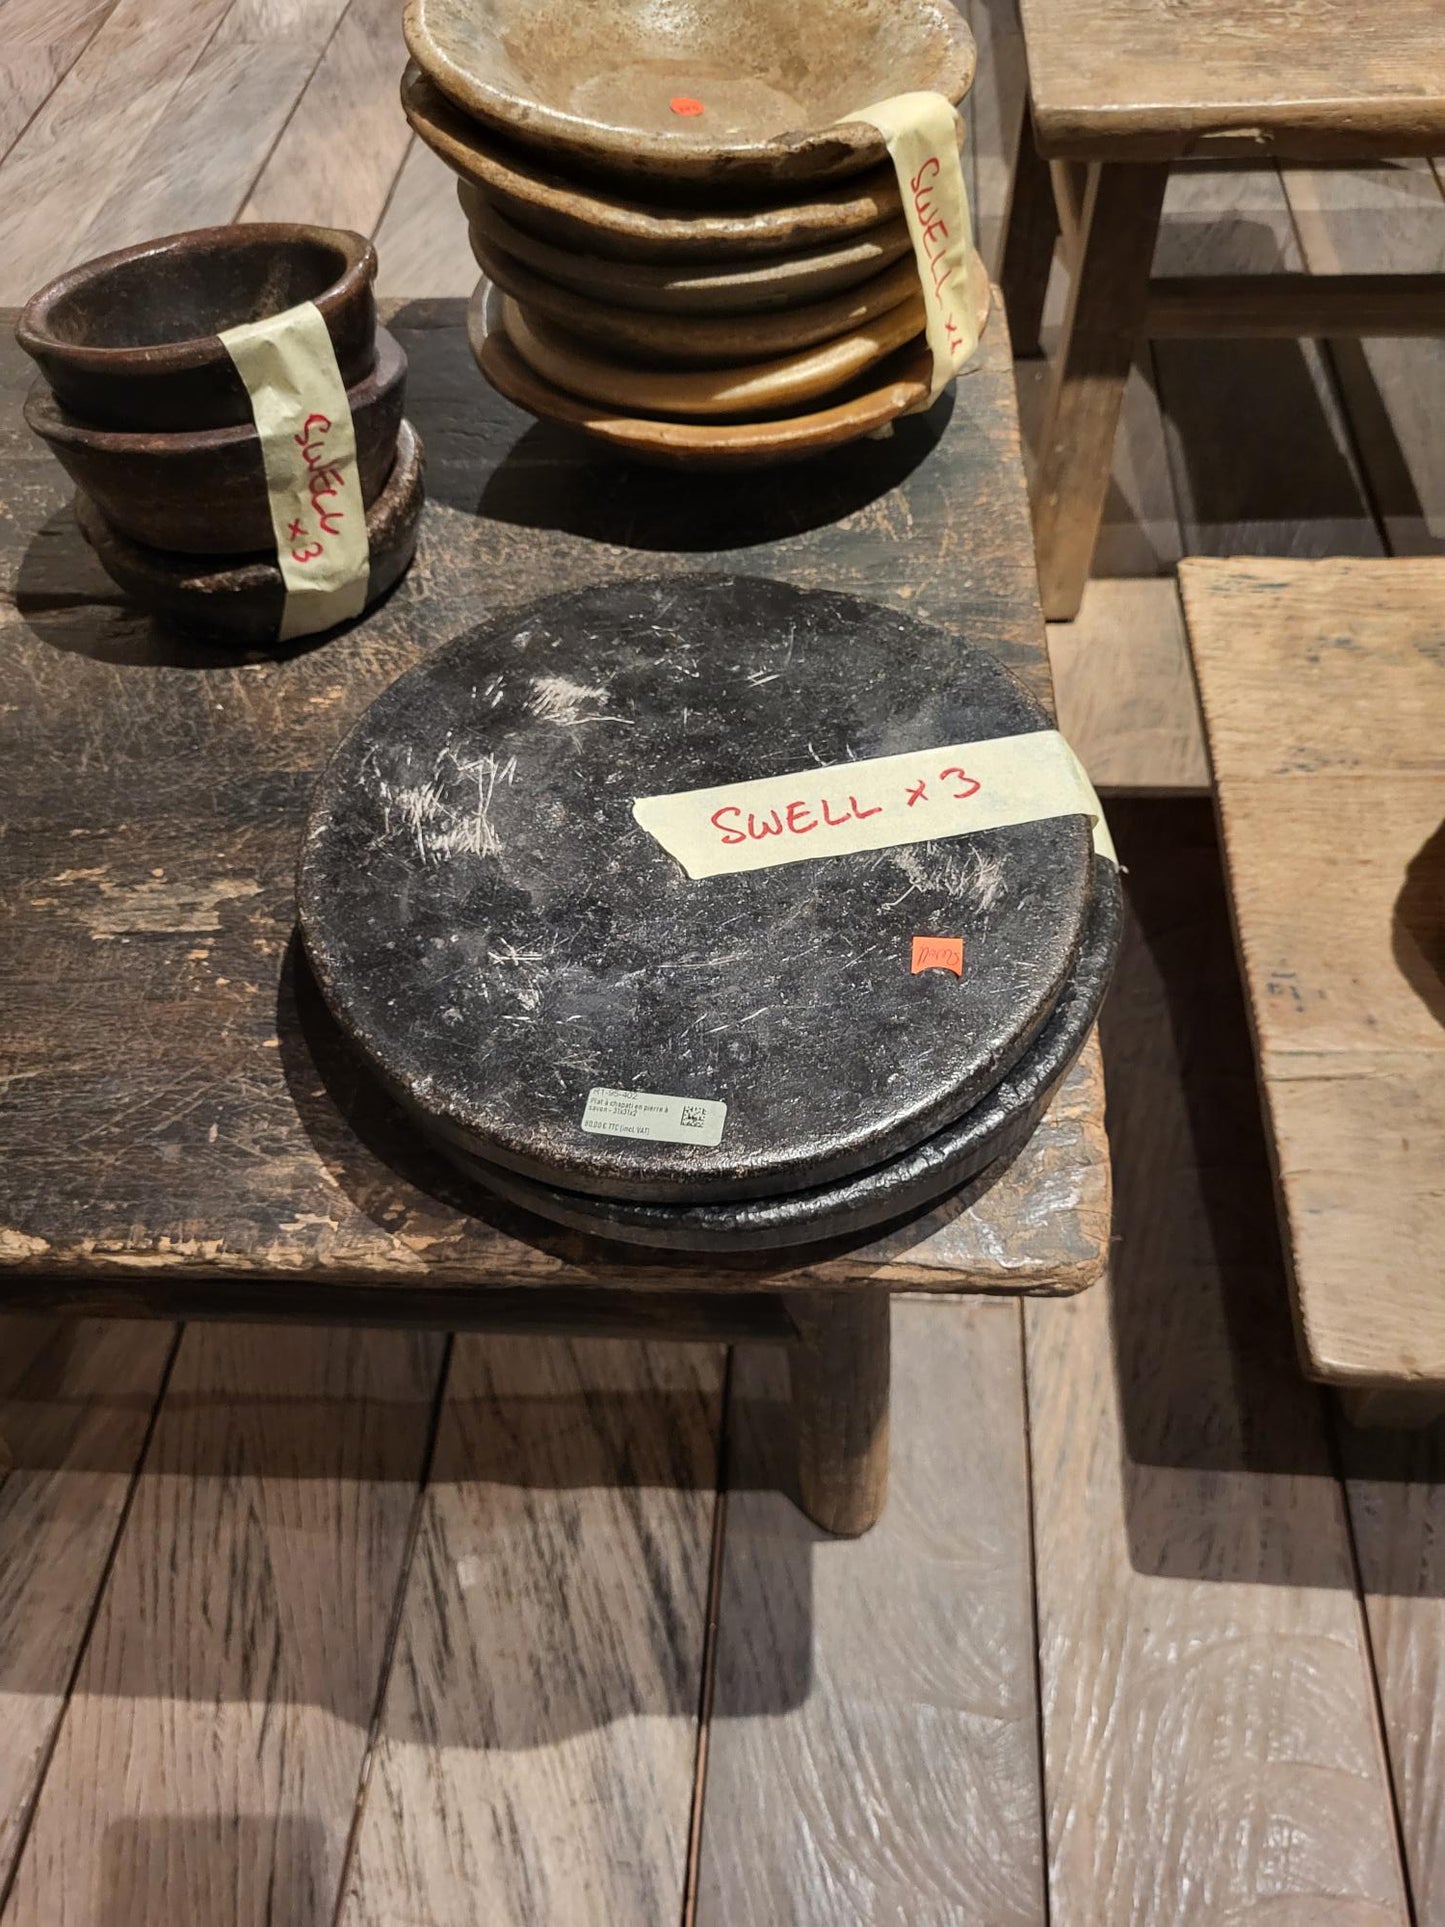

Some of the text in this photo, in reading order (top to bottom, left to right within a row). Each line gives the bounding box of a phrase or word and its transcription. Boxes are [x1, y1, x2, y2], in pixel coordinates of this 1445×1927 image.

[910, 157, 951, 310] SWELL
[295, 414, 344, 535] SWELL
[711, 796, 881, 844] SWELL
[609, 1101, 634, 1111] chapati
[643, 1105, 663, 1113] pierre
